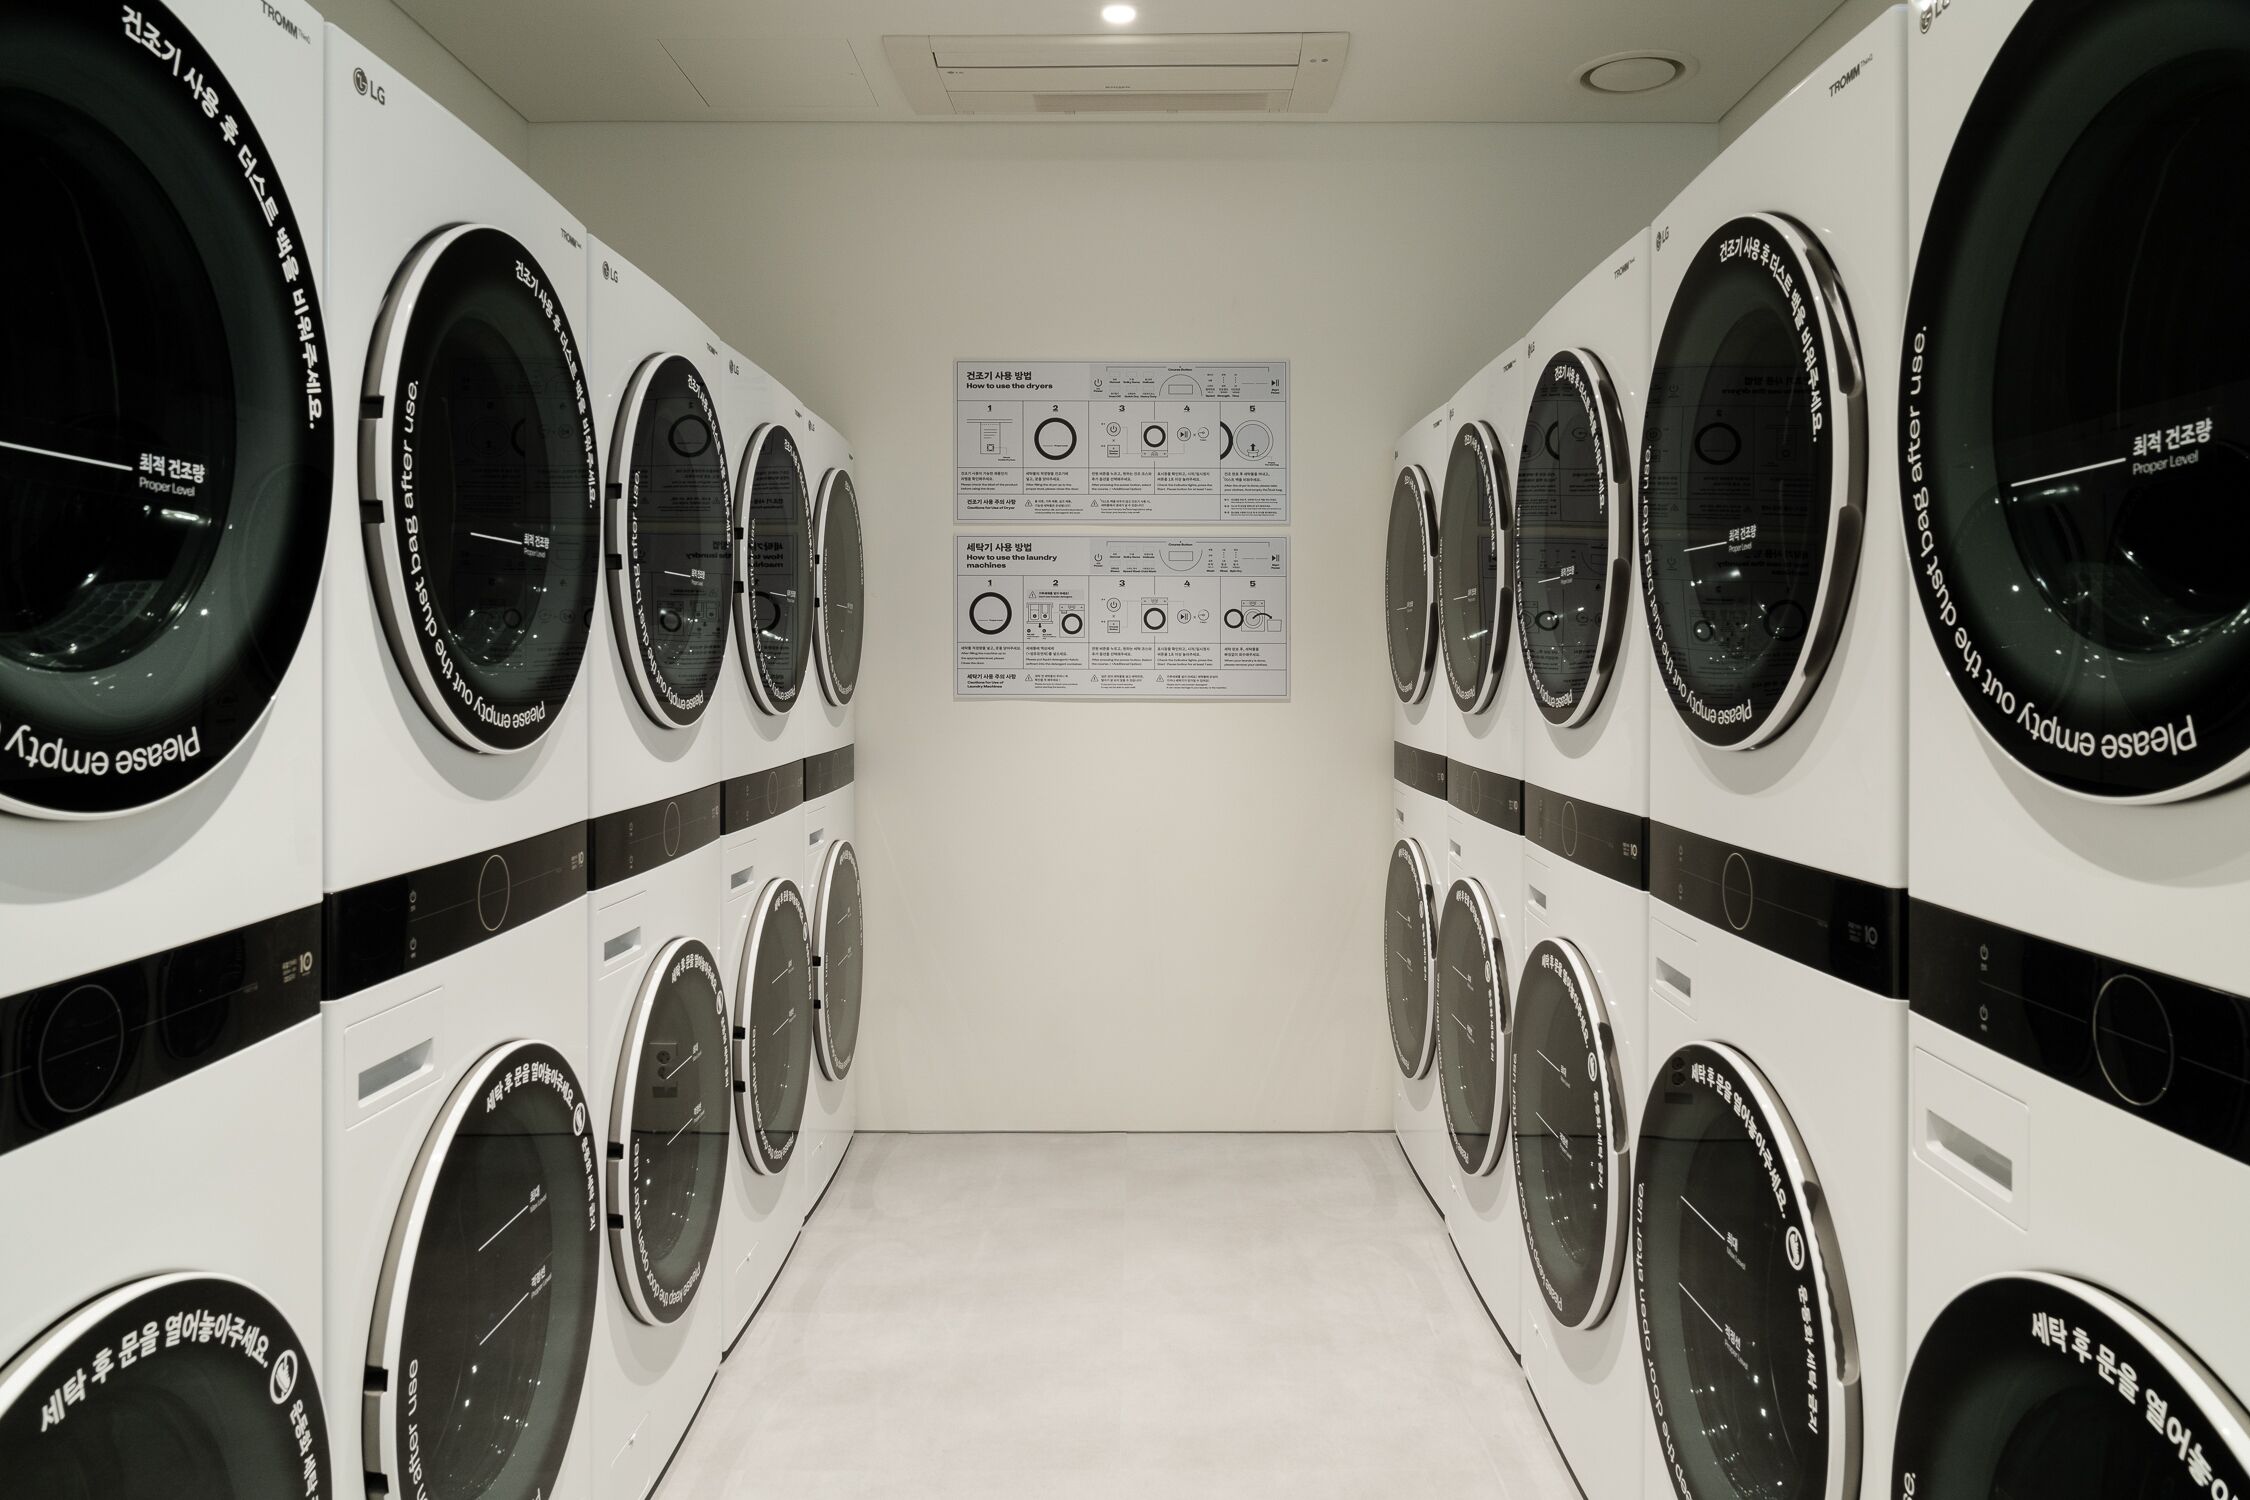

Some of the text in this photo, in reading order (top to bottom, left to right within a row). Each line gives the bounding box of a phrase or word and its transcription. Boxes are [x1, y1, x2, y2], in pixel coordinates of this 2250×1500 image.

[260, 0, 297, 40] TROMM
[370, 79, 386, 106] LG
[1828, 63, 1858, 98] TROMM
[122, 5, 322, 429] 건조기 사용 후 더스트 백을 비워주세요.
[1661, 226, 1670, 244] LG
[610, 267, 620, 284] LG
[1720, 236, 1823, 443] 건조기 사용 후 더스트 백을 비워주세요.
[515, 260, 597, 509] 건조기 사용 후 더스트 백을 비워주세요.
[966, 371, 1032, 381] 건조기 사용 방법
[1026, 383, 1053, 391] dryers
[987, 404, 992, 412] 1
[1052, 404, 1059, 412] 2
[1119, 404, 1126, 412] 3
[1184, 404, 1190, 412] 4
[1249, 404, 1256, 412] 5
[2132, 417, 2213, 457] 최적 건조량
[139, 453, 206, 484] 최적 건조량
[1643, 445, 1652, 489] use.
[2132, 449, 2199, 476] Proper Level
[139, 476, 196, 497] Proper Level
[401, 380, 546, 729] Please empty out the dust bag after use.
[966, 543, 1032, 552] 세탁기 사용 방법
[1026, 554, 1057, 562] laundry
[1907, 325, 2198, 759] Please empty out the dust bag after use.
[987, 579, 993, 587] 1
[1052, 579, 1059, 587] 2
[1119, 579, 1126, 587] 3
[1184, 579, 1191, 587] 4
[1249, 579, 1256, 587] 5
[1645, 549, 1654, 595] bag
[1650, 595, 1663, 641] dust
[1661, 641, 1674, 674] the
[1673, 668, 1687, 698] out
[1686, 690, 1716, 724] empty
[1718, 698, 1752, 725] Please
[4, 724, 201, 776] Please empty
[1864, 925, 1879, 946] 10
[298, 951, 312, 974] 10
[486, 1061, 574, 1113] 세탁 후 문을 열어놓아주세요.
[1691, 1063, 1787, 1219] 세탁 후 문을 열어놓아주세요.
[581, 1136, 596, 1231] 운동화 세탁 금지
[1637, 1182, 1645, 1224] use.
[1636, 1226, 1645, 1281] after
[1640, 1288, 1651, 1351] open
[41, 1309, 270, 1432] 세탁 후 문을 열어놓아주세요.
[1798, 1285, 1819, 1434] 운동화 세탁 금지
[2031, 1312, 2067, 1353] 세탁
[2071, 1327, 2092, 1363] 후
[2096, 1344, 2140, 1404] 문을
[1648, 1358, 1663, 1416] door
[289, 1399, 319, 1498] 운동화 세탁
[408, 1424, 422, 1485] after
[1662, 1421, 1675, 1463] the
